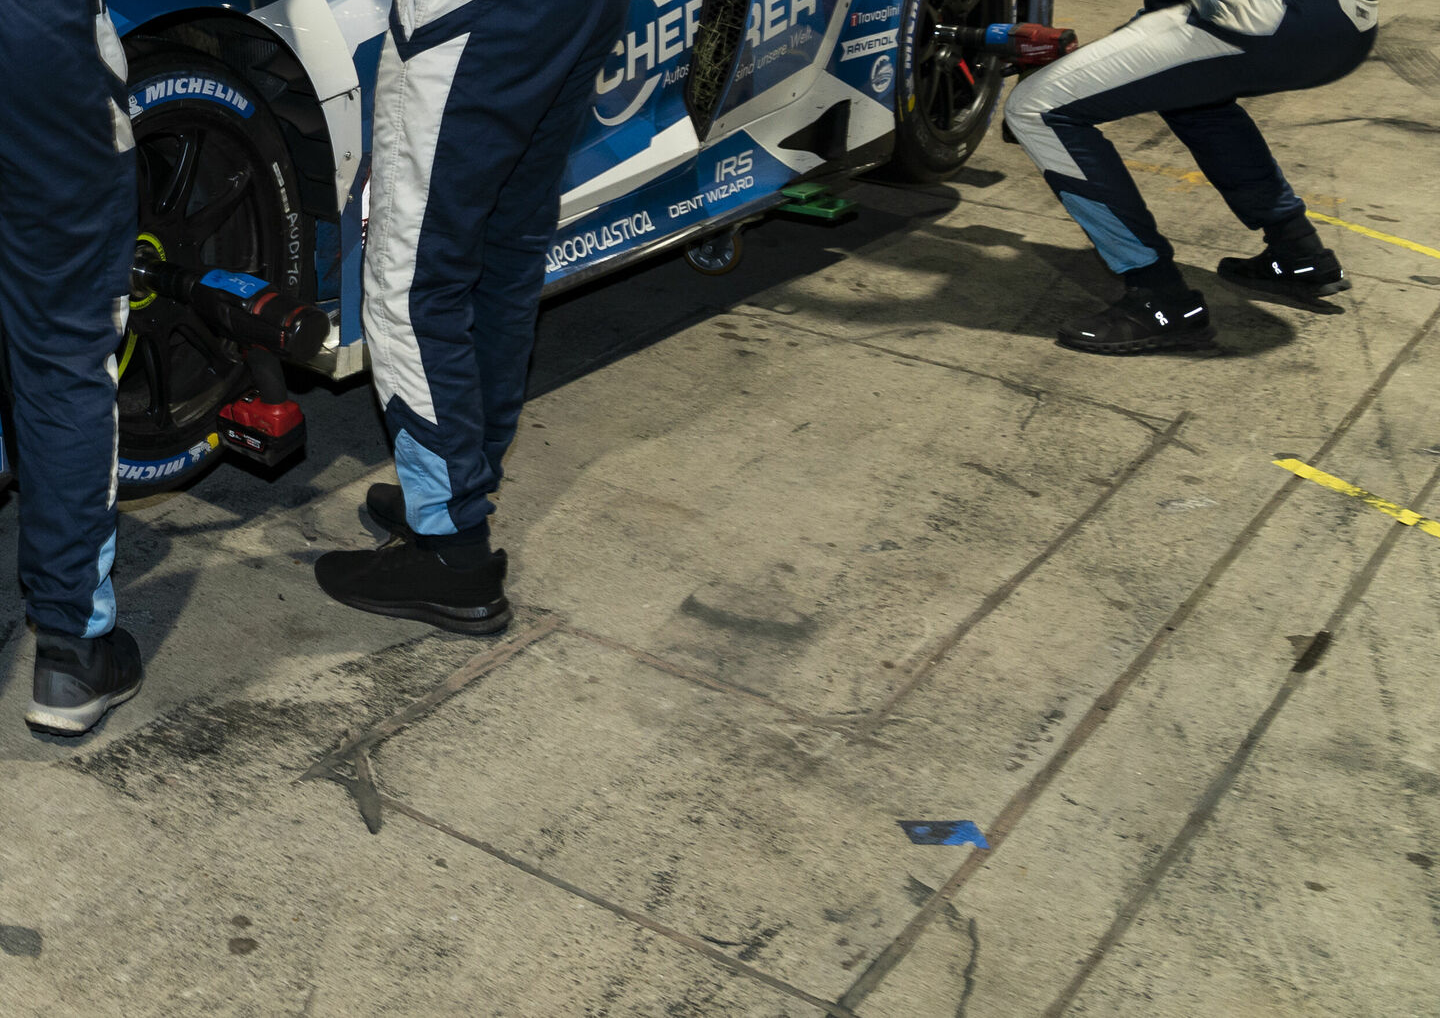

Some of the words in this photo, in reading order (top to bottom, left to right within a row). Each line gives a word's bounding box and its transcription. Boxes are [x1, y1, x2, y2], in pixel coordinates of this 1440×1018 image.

[857, 4, 900, 25] Travaglini
[846, 36, 894, 54] RAVENOL
[662, 63, 690, 89] Autos
[734, 60, 754, 83] sind
[756, 47, 789, 71] unsere
[145, 76, 249, 112] MICHELIN
[714, 148, 754, 183] IRS
[668, 199, 704, 219] DENT
[706, 174, 754, 202] WIZARD
[545, 210, 656, 274] ARCOPLASTICA
[118, 457, 186, 480] MICHE
